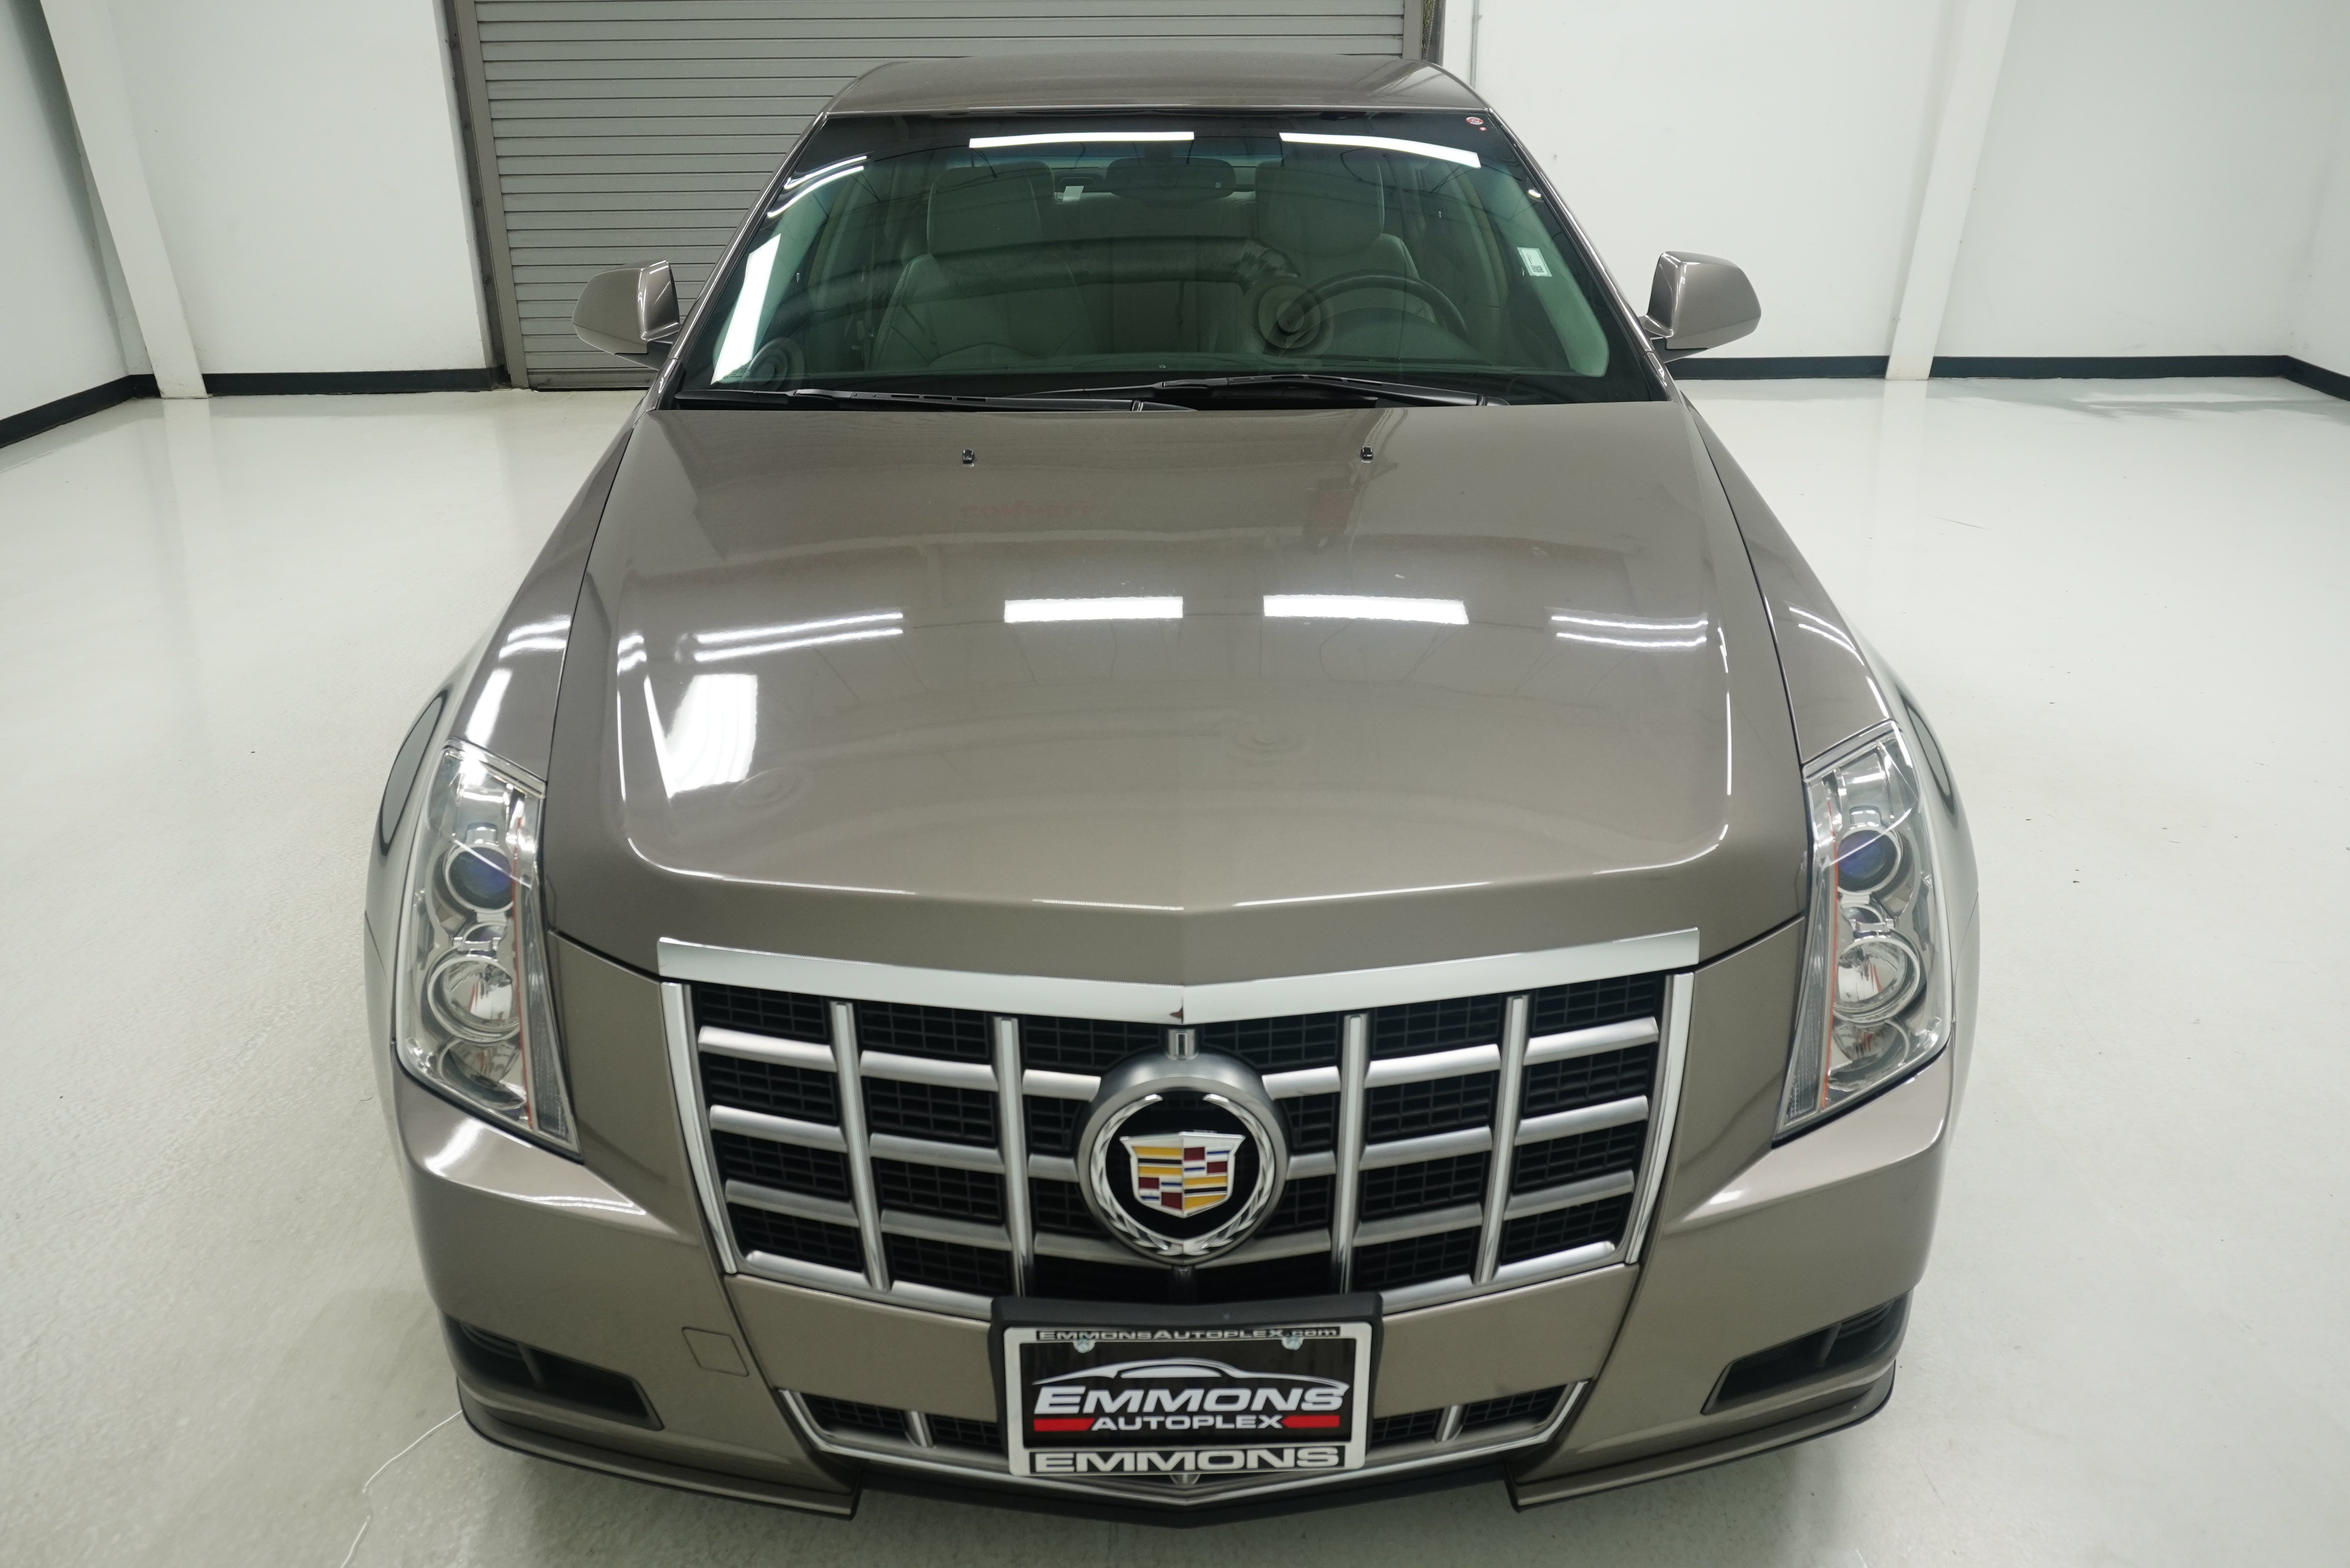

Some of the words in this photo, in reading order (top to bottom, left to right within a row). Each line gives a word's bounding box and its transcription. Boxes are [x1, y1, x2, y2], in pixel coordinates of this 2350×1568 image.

[1034, 1386, 1343, 1414] EMMONS
[1092, 1415, 1284, 1431] AUTOPLEX
[1035, 1447, 1339, 1473] EMMONS
